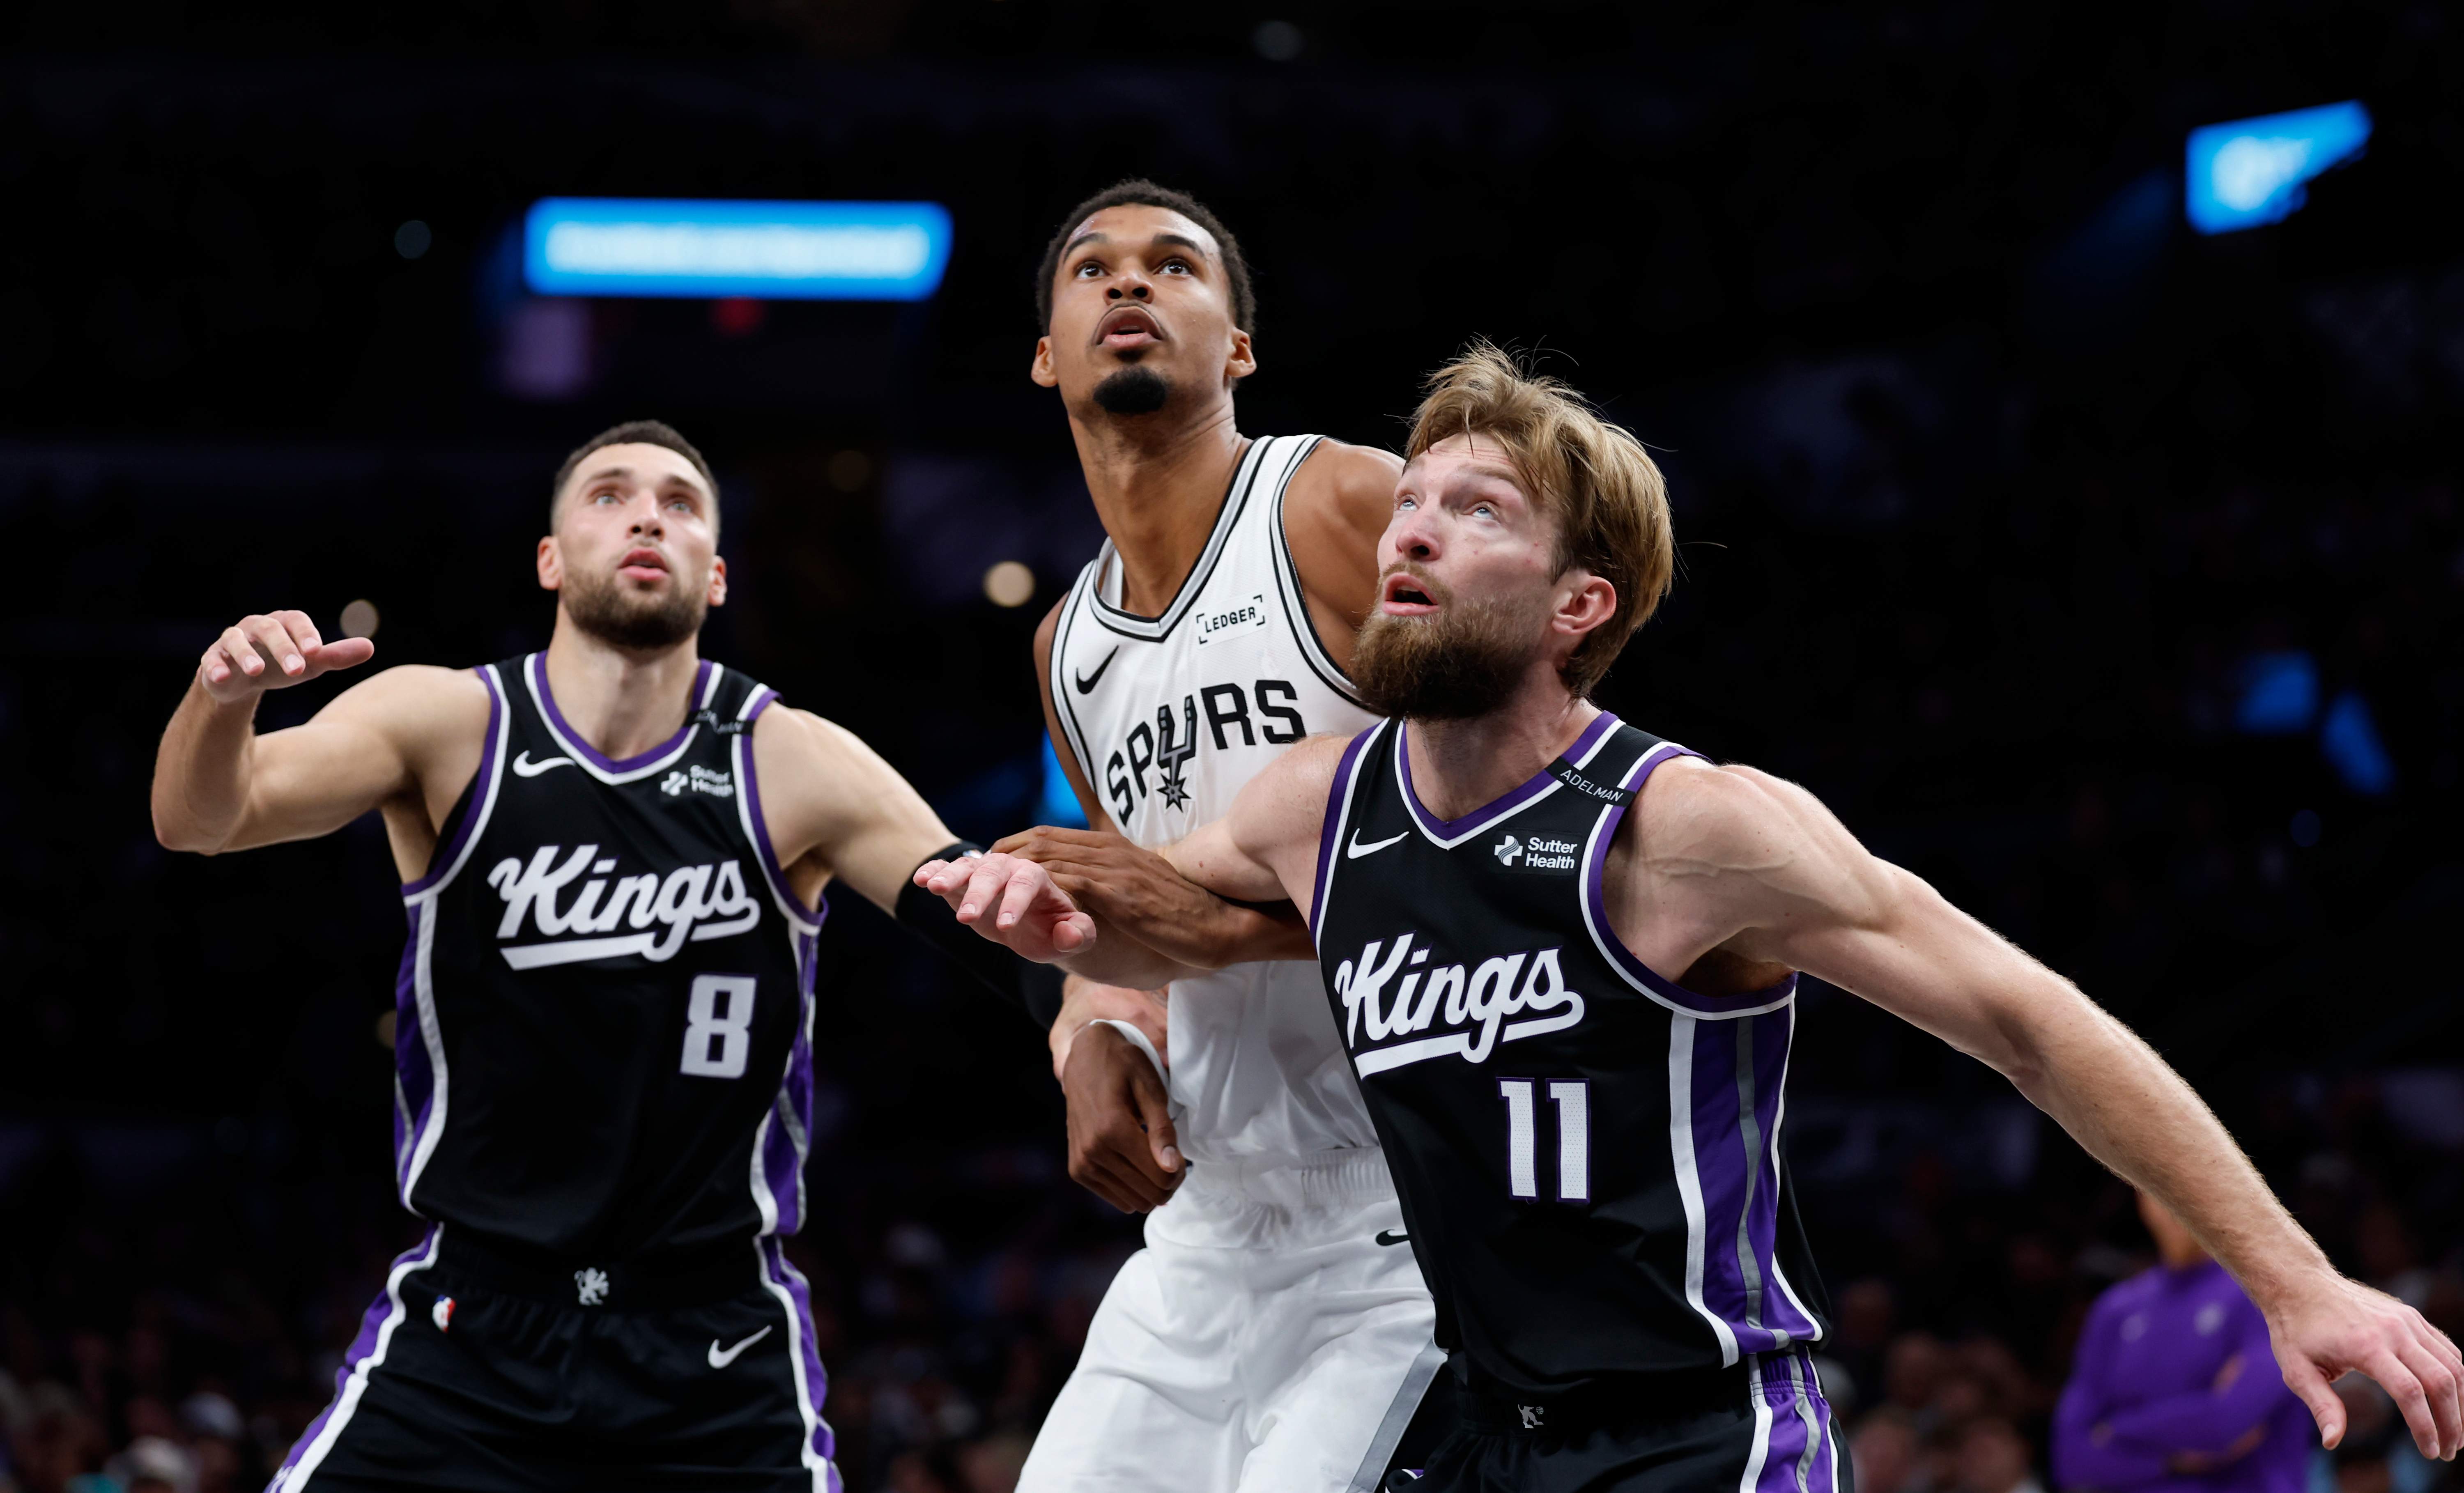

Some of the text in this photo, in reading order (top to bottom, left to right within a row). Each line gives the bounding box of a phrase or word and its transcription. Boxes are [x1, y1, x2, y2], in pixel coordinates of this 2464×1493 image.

[1205, 606, 1256, 633] LEDGER
[1107, 680, 1307, 827] SPURS
[1560, 769, 1624, 802] ADELMAN
[1525, 852, 1575, 869] Health
[1528, 837, 1578, 854] Sutter
[487, 844, 760, 970] Kings
[680, 975, 756, 1078] 8
[1334, 933, 1585, 1080] Kings
[1497, 1077, 1590, 1202] 11
